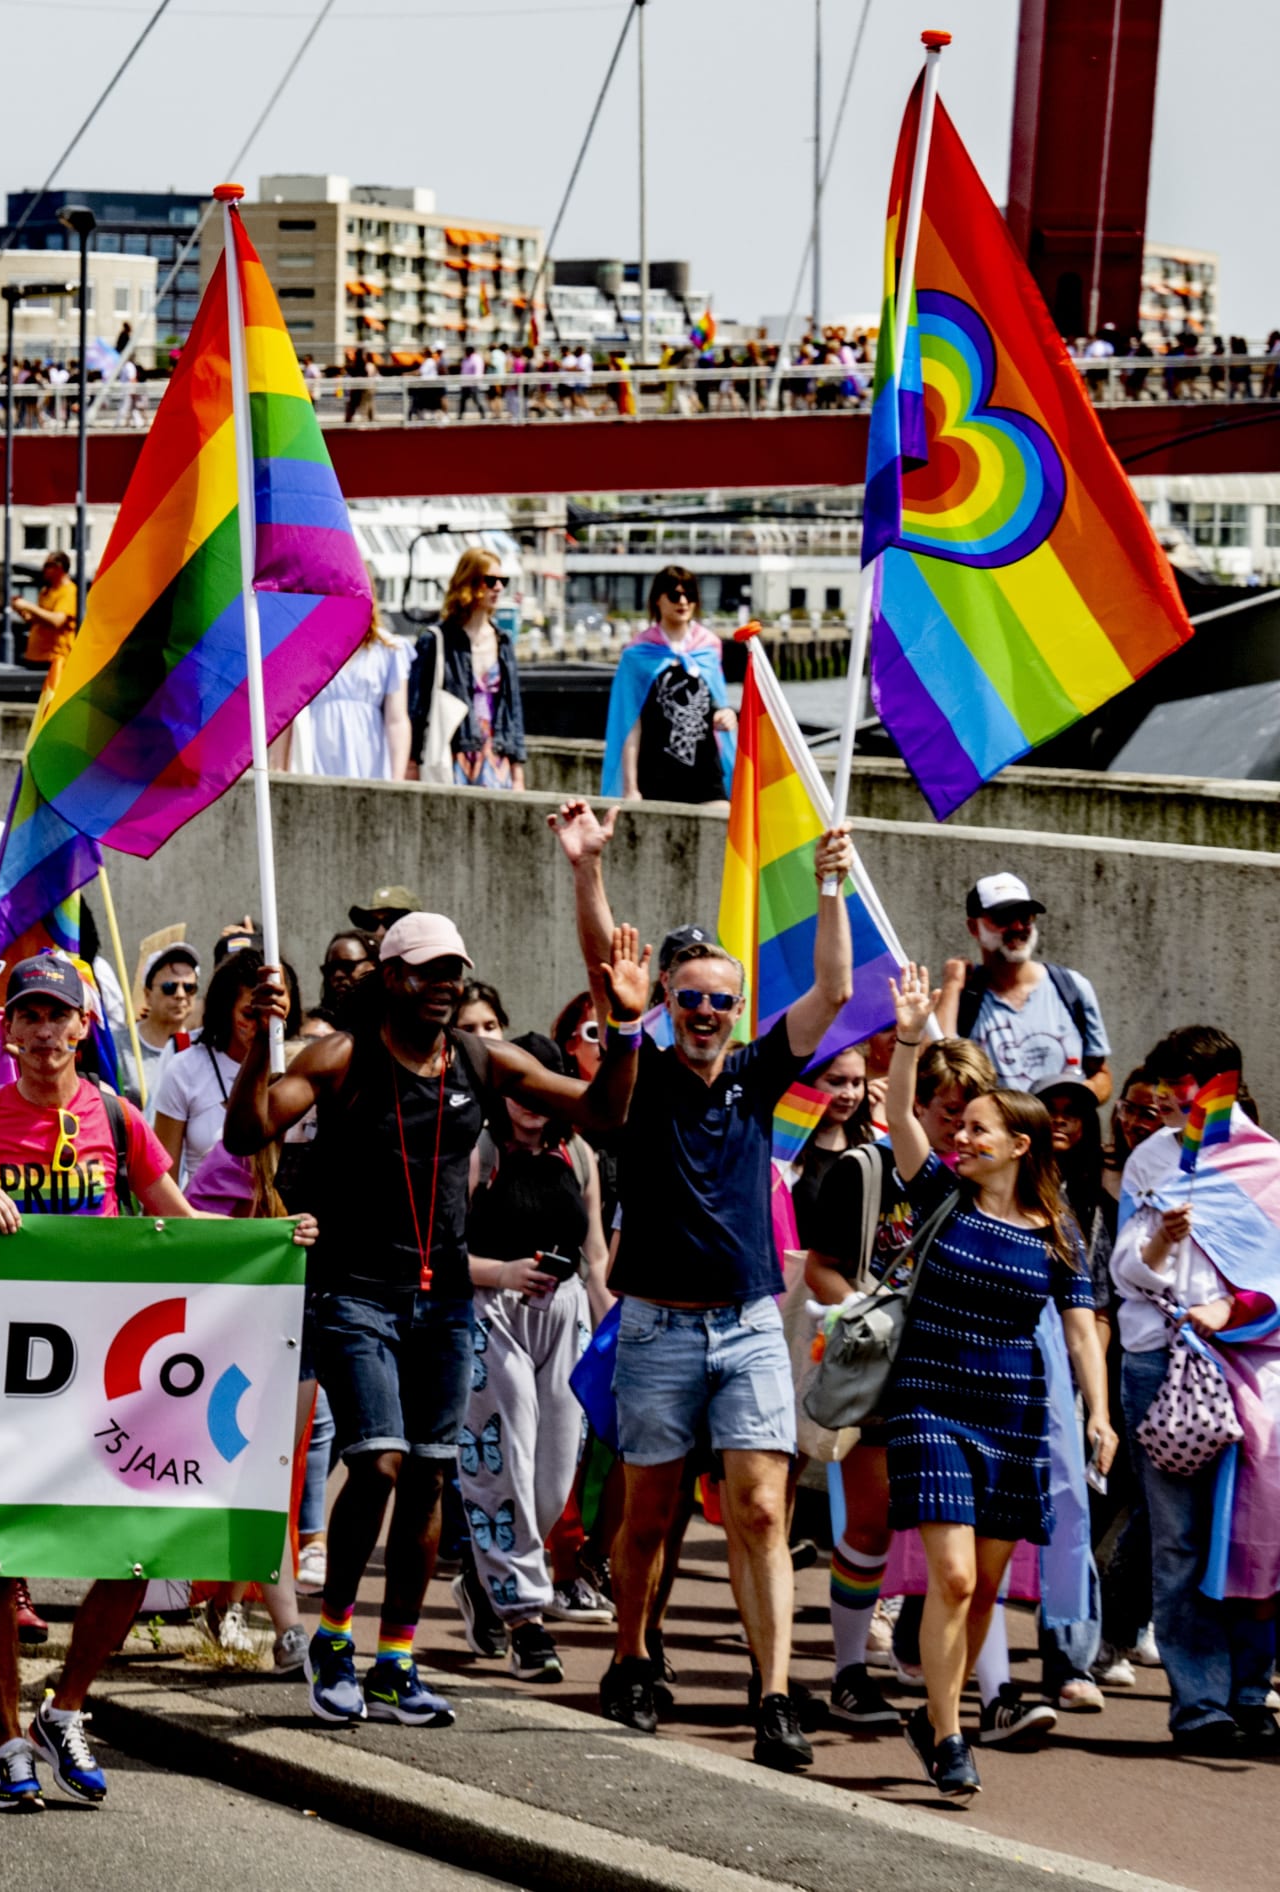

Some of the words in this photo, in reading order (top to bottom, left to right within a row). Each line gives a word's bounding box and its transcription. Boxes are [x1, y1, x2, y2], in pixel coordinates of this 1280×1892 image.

[0, 1158, 102, 1214] PRIDE
[94, 1418, 130, 1454] 75
[119, 1445, 203, 1486] JAAR
